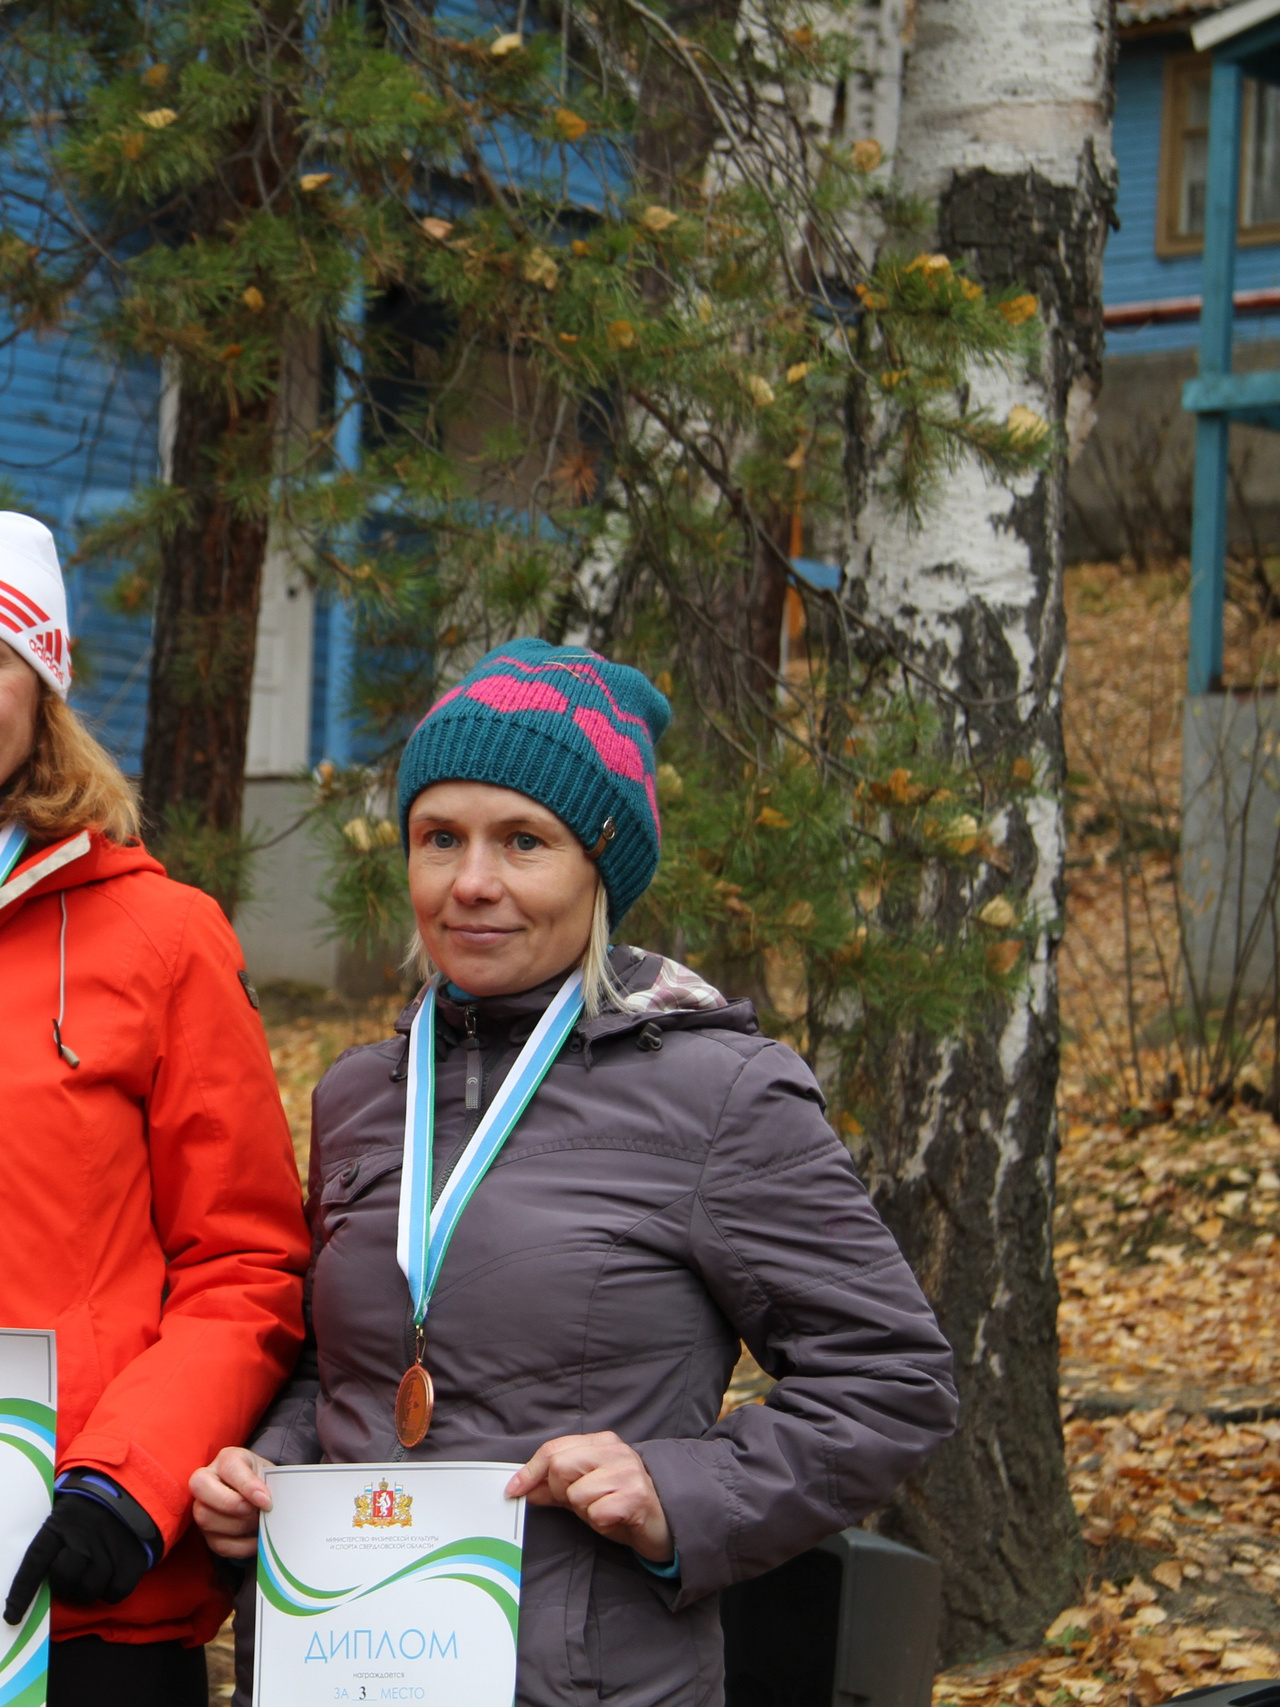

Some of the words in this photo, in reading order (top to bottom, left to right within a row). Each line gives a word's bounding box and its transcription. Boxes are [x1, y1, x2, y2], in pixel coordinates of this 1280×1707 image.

[304, 1628, 458, 1664] ДИПЛОМ
[352, 1671, 405, 1679] награждается
[333, 1687, 349, 1700] ЗА
[358, 1685, 367, 1700] 3
[380, 1686, 425, 1700] МЕСТО
